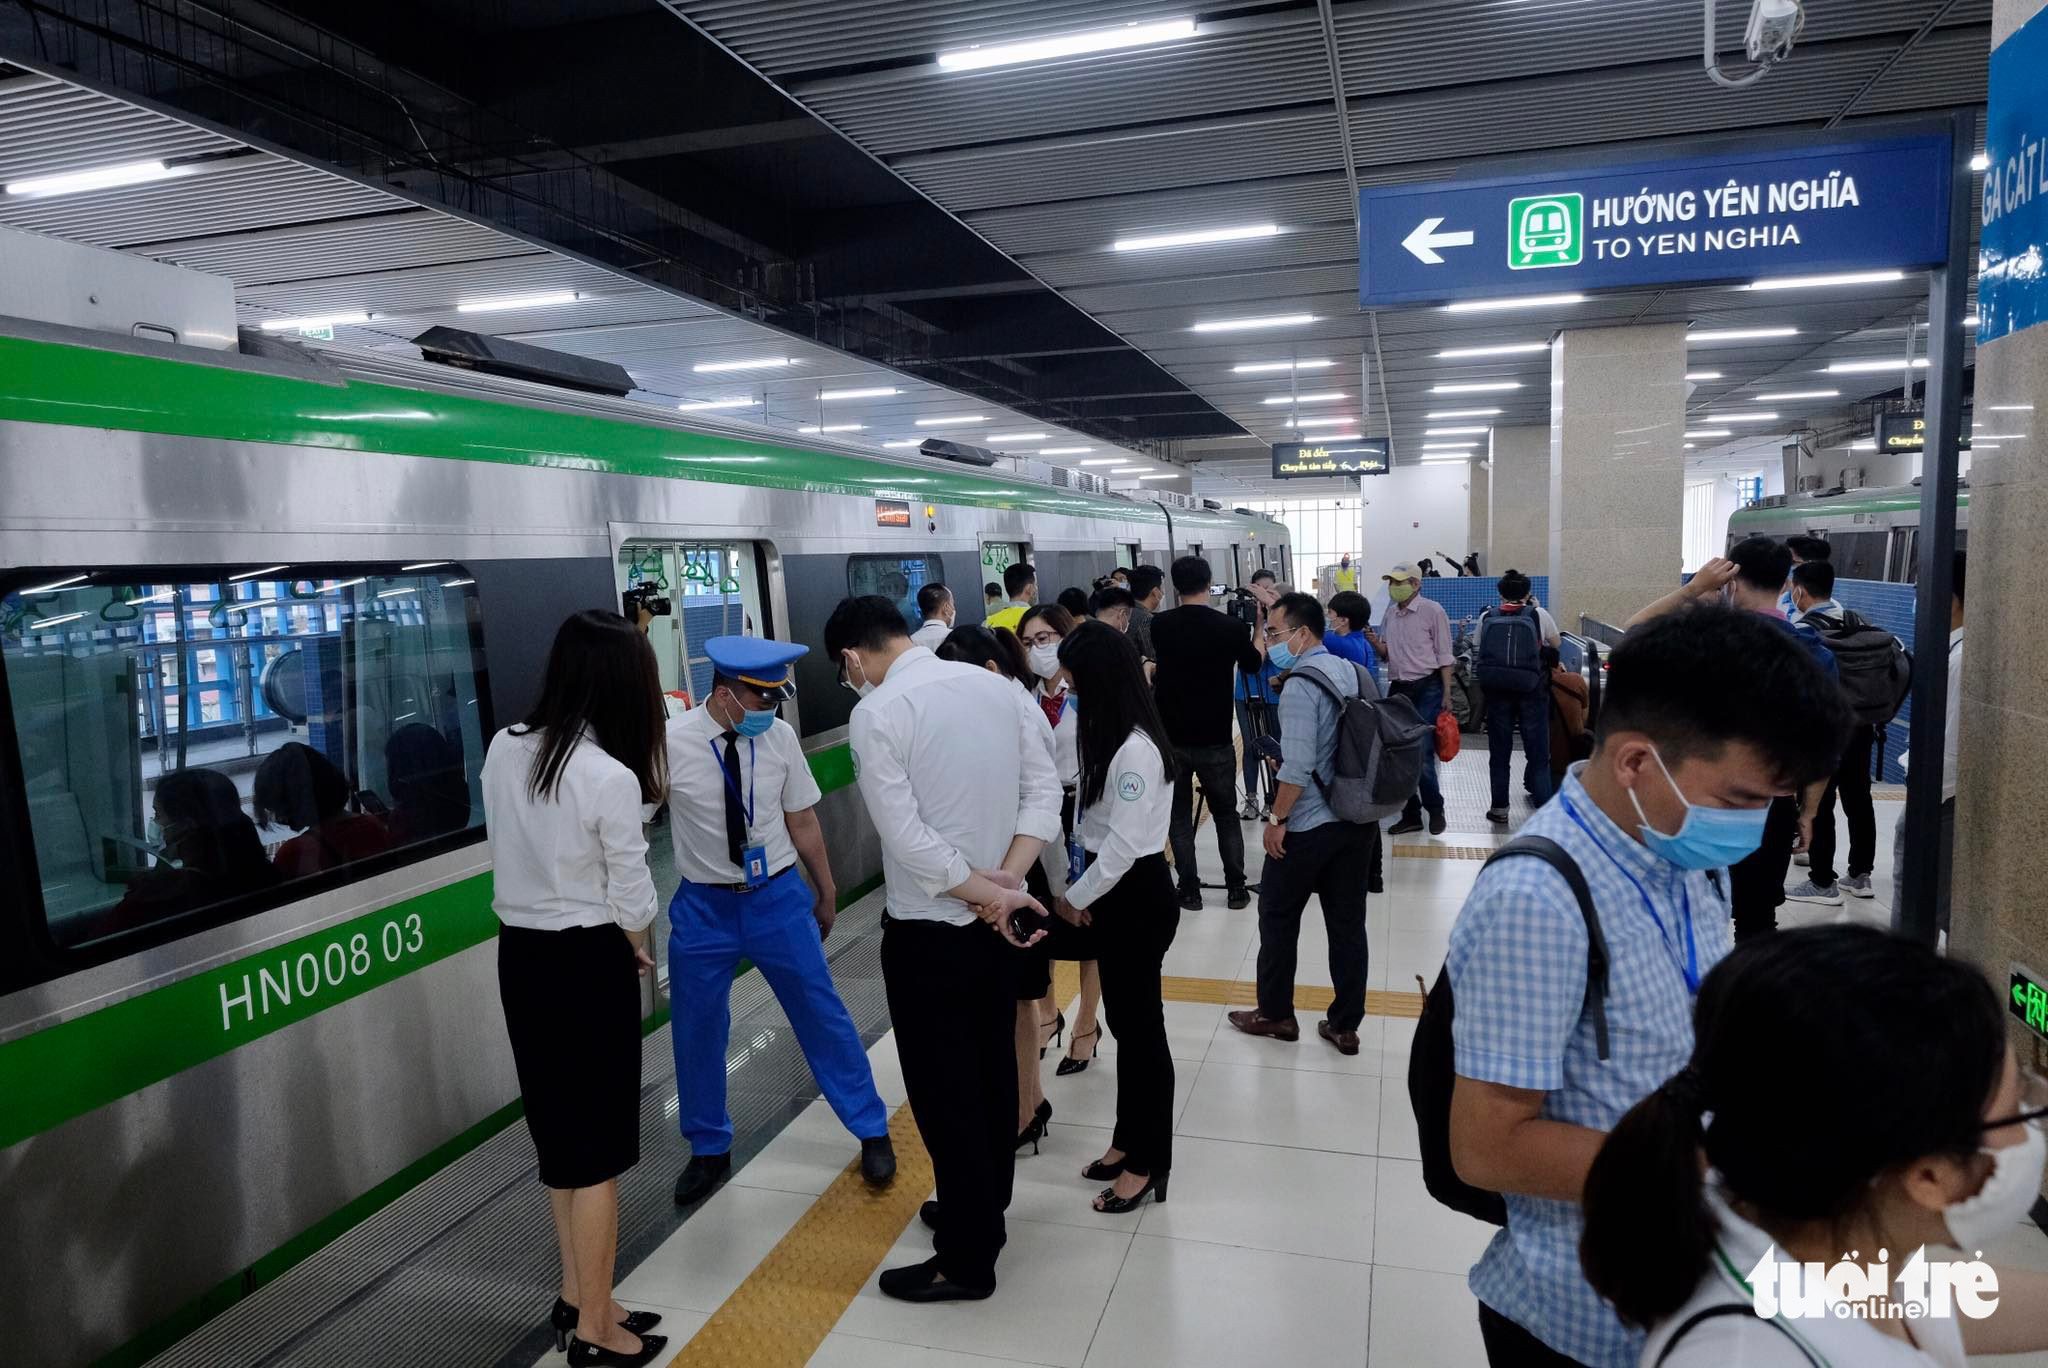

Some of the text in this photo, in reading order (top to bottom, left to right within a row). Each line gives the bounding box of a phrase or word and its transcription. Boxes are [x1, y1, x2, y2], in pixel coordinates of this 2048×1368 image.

[1592, 170, 1860, 229] HƯỚNG YÊN NGHĨA
[1982, 166, 2001, 227] GA
[2005, 134, 2037, 214] CÁT
[1593, 223, 1801, 260] TO YEN NGHIA
[219, 913, 424, 1031] HN008 03
